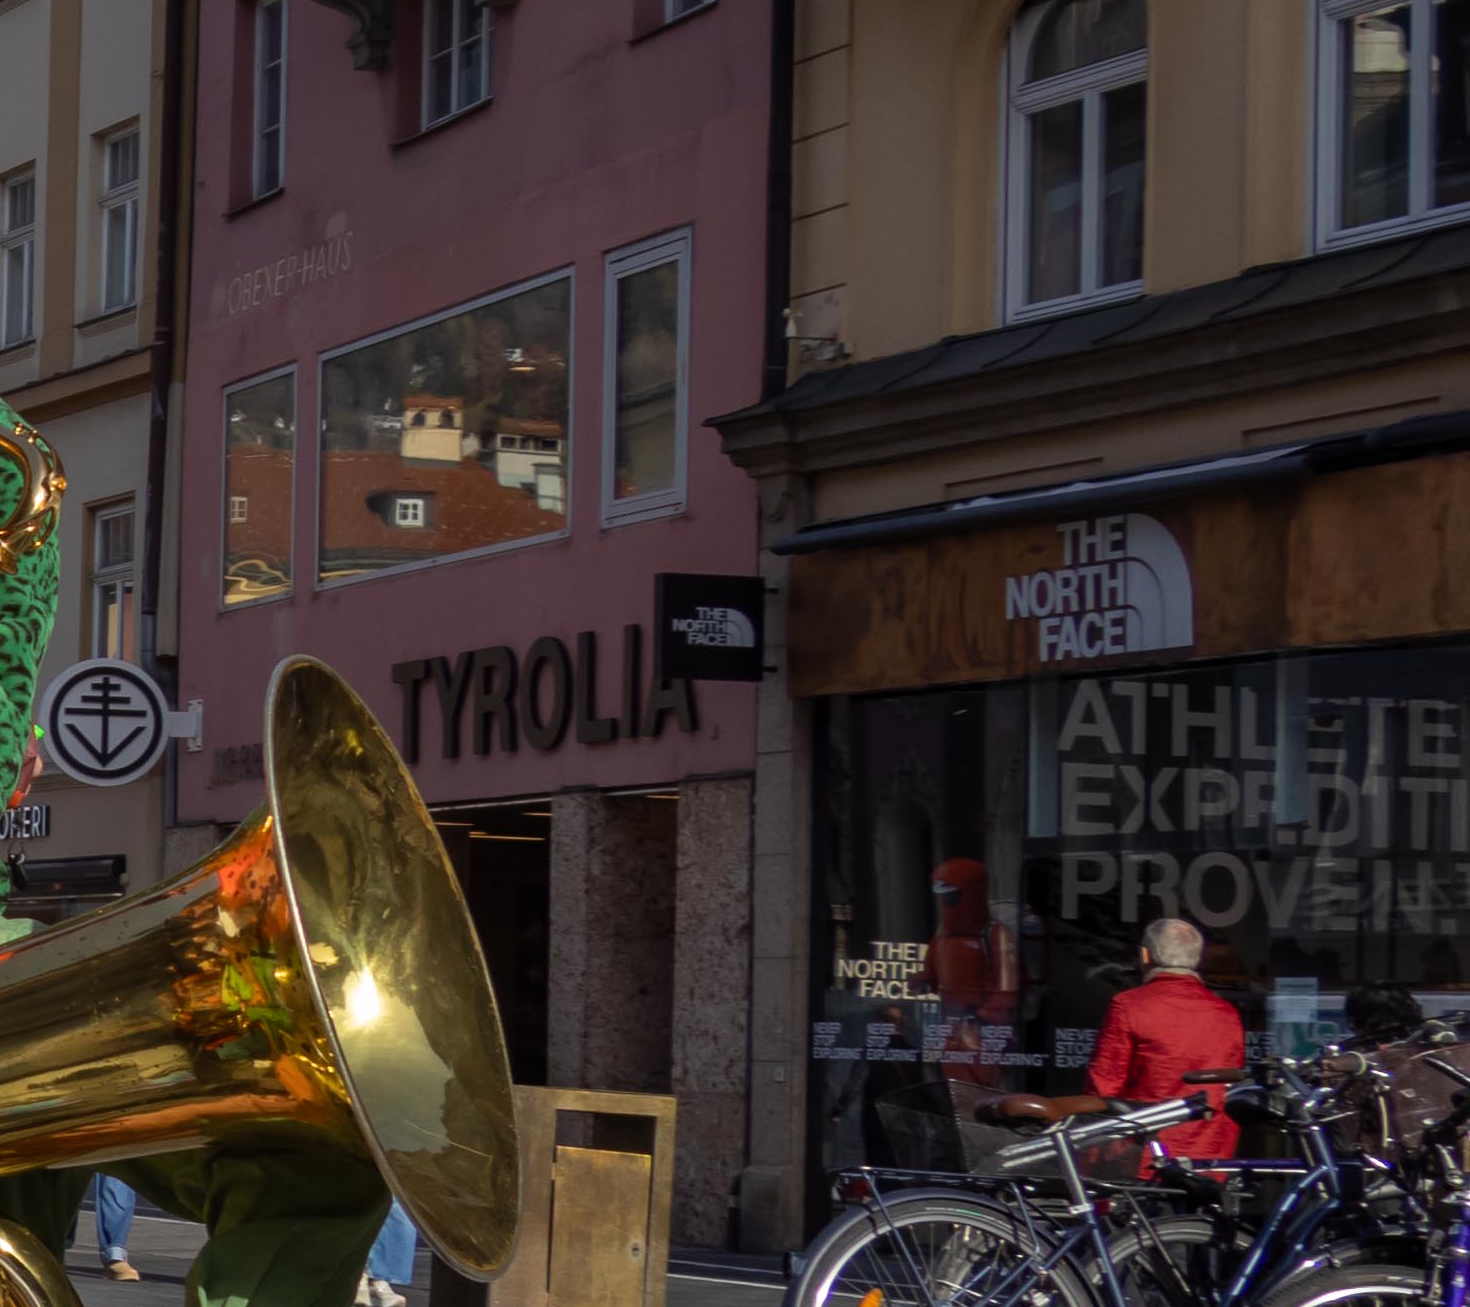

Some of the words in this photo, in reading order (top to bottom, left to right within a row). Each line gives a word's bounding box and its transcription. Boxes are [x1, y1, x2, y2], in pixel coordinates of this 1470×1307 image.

[227, 230, 354, 315] OBEXER-HAUS
[1056, 513, 1128, 568] THE
[1005, 560, 1128, 622] NORTH
[696, 606, 728, 621] THE
[671, 618, 726, 633] NORTH
[1038, 609, 1128, 662] FACE
[687, 632, 729, 646] FACE
[391, 623, 700, 765] TYROLIA
[869, 941, 917, 961] THE
[838, 959, 918, 980] NORTH
[1055, 1028, 1099, 1042] NEVE
